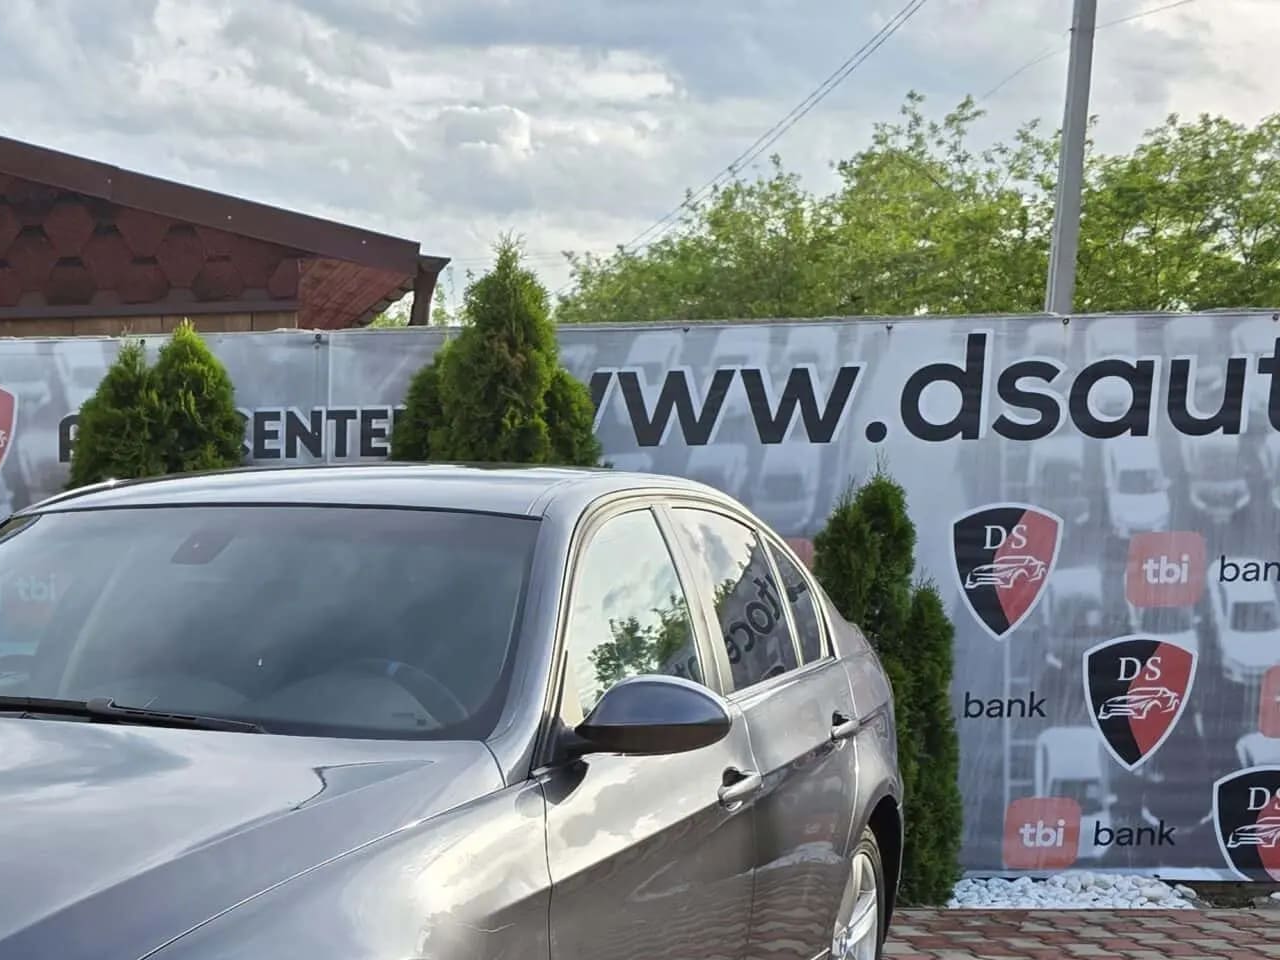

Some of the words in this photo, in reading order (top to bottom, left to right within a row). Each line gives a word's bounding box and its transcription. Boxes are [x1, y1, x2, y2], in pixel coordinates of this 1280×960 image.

[590, 332, 1280, 447] ww.dsau
[241, 408, 408, 459] ENTE
[983, 524, 1028, 550] DS
[1142, 554, 1190, 585] tbi
[1118, 656, 1162, 682] DS
[963, 691, 1048, 719] bank
[1019, 819, 1066, 848] tbi
[1093, 820, 1177, 847] bank
